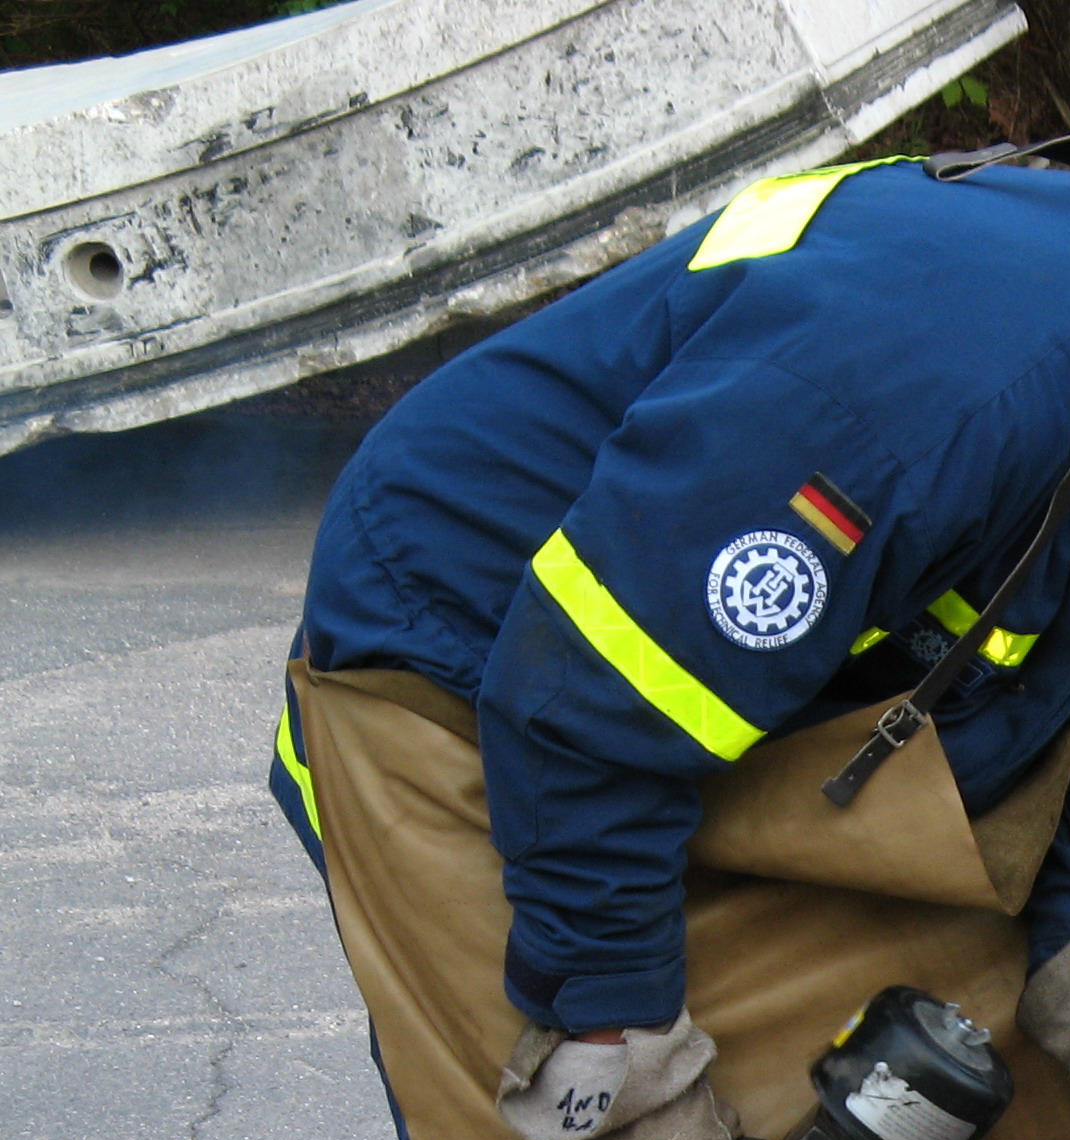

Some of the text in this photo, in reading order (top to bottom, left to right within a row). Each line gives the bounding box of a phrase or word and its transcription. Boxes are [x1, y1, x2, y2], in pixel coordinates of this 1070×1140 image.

[708, 571, 788, 649] FOR TECHNICAL RELIEF
[726, 531, 827, 629] GERMAN FEDERAL AGENCY
